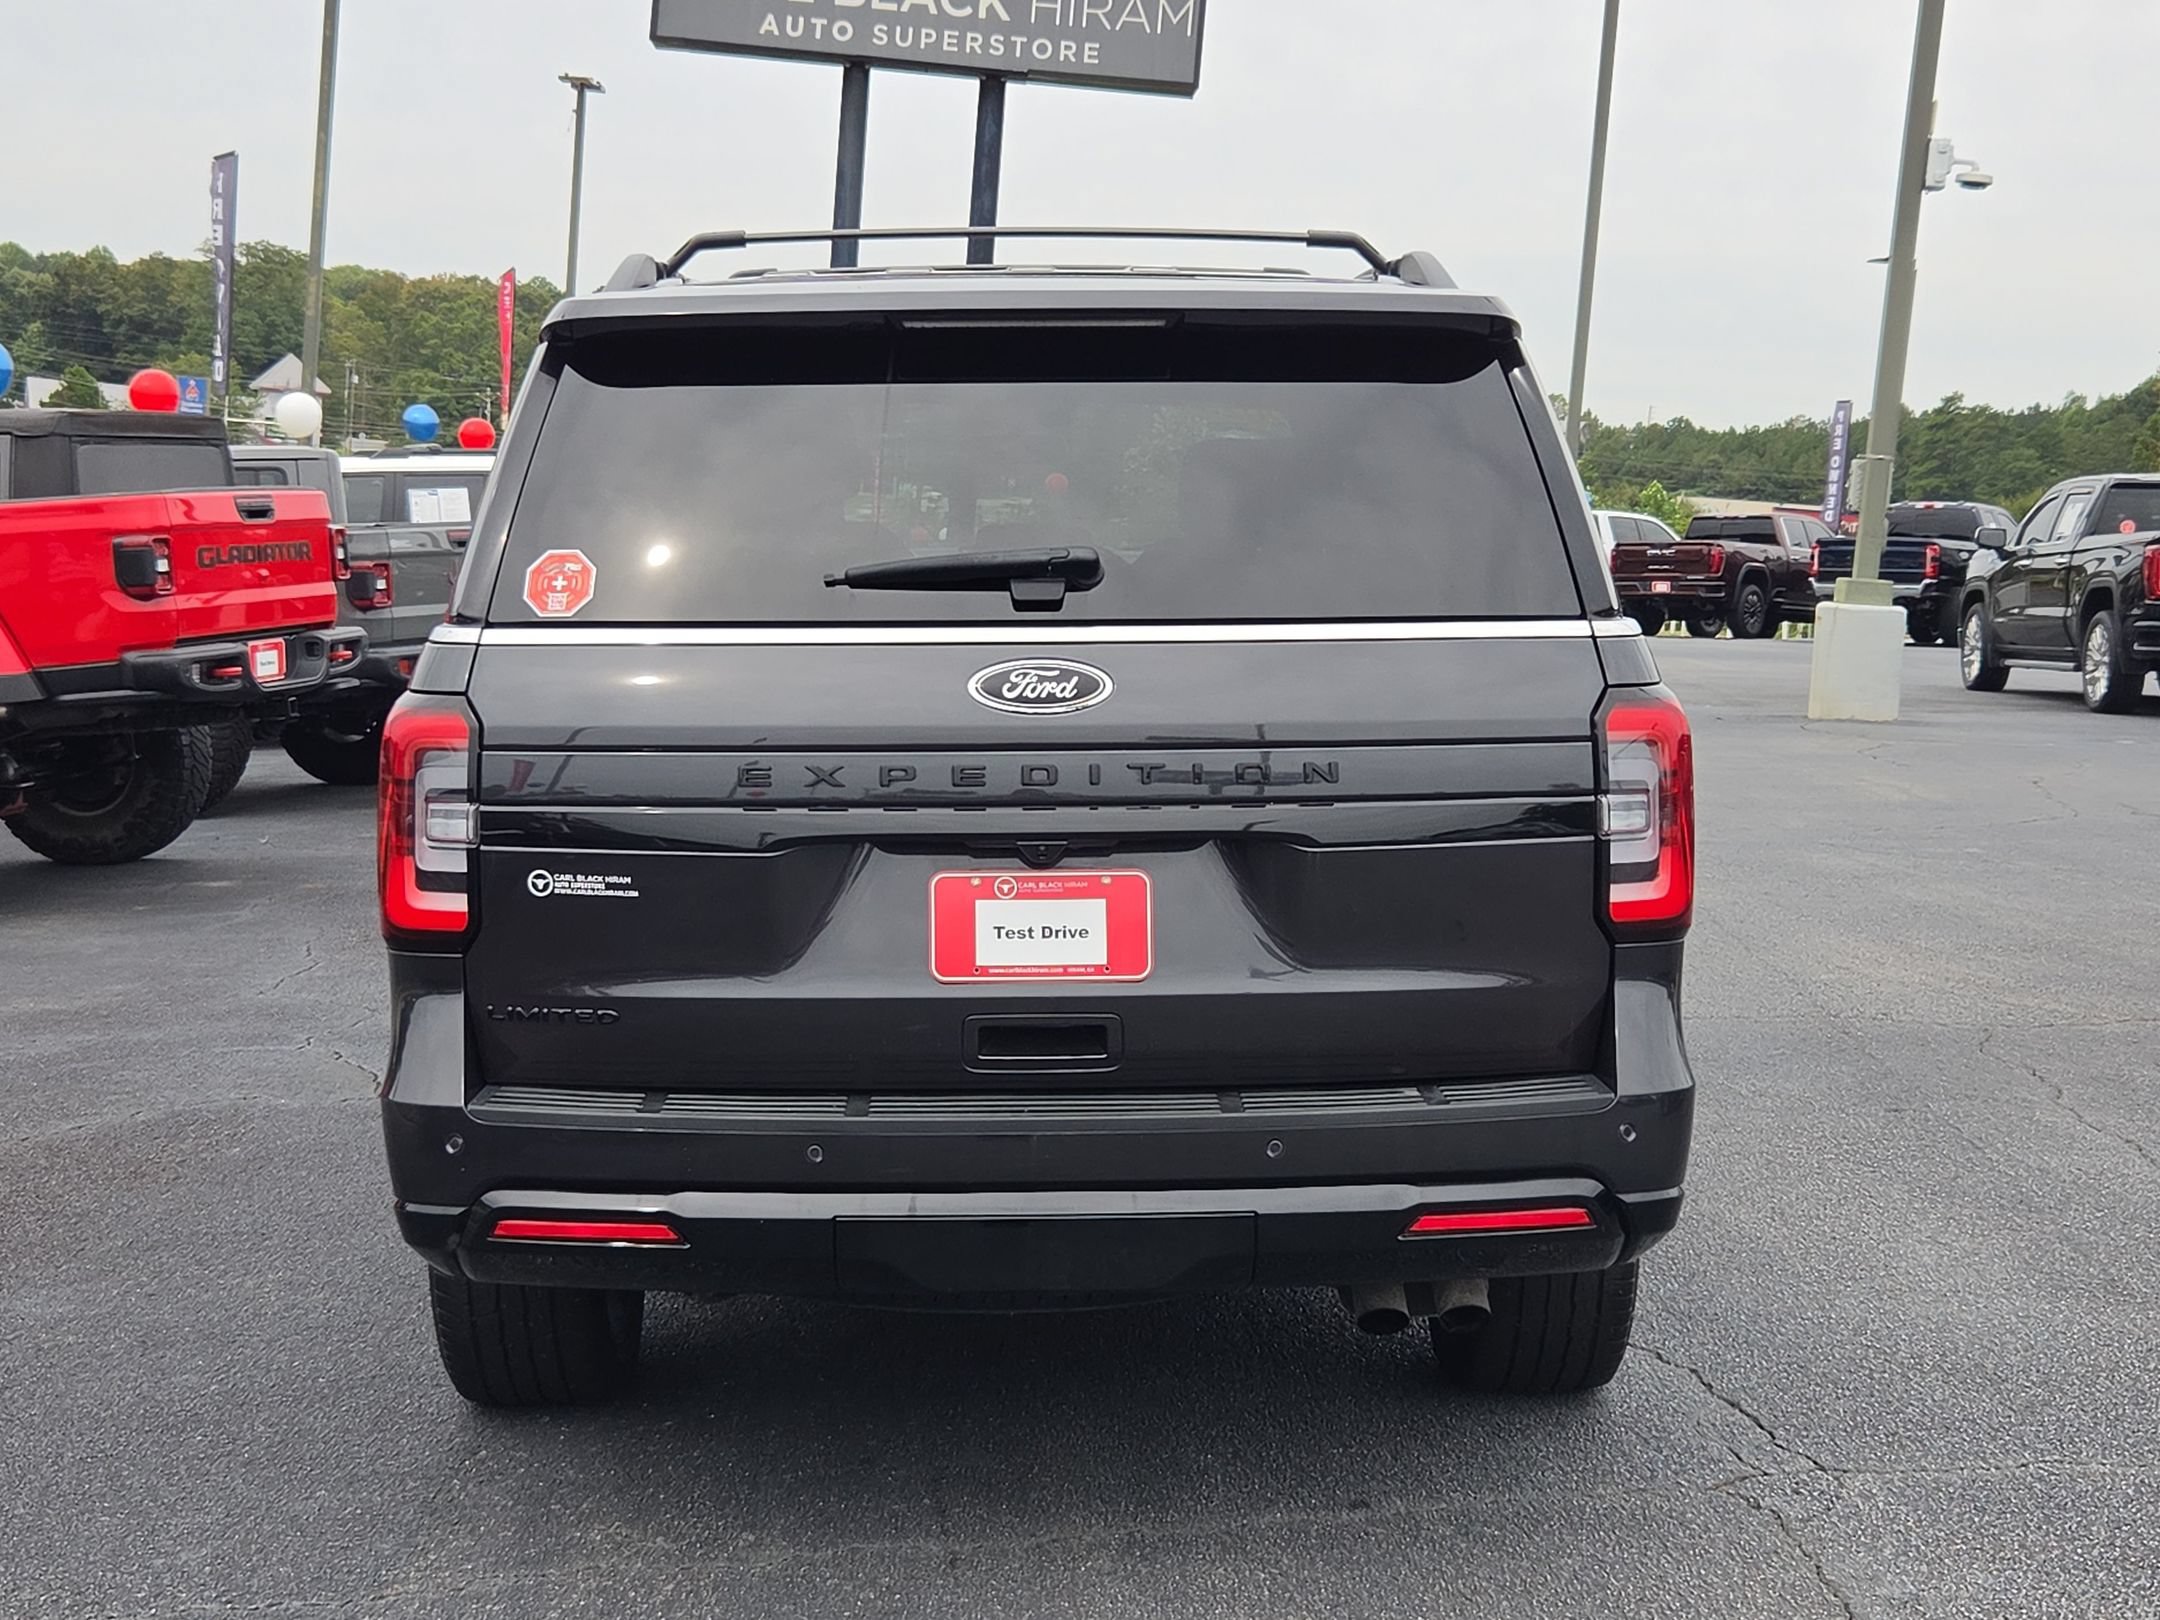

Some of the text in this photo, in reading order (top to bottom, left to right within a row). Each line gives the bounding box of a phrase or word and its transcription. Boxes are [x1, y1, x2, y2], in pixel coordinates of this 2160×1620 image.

[1030, 0, 1193, 37] HIRAM
[759, 12, 1100, 64] AUTO SUPERSTORE
[197, 541, 312, 569] GLADIATOR
[1001, 668, 1079, 699] Ford
[737, 761, 1339, 788] EXPEDITION
[553, 873, 631, 885] CARL BLACK HIRAM
[1018, 881, 1037, 889] CARL
[1039, 881, 1062, 889] BLACK
[993, 925, 1089, 940] Test Drive
[487, 1004, 619, 1023] LIMITED
